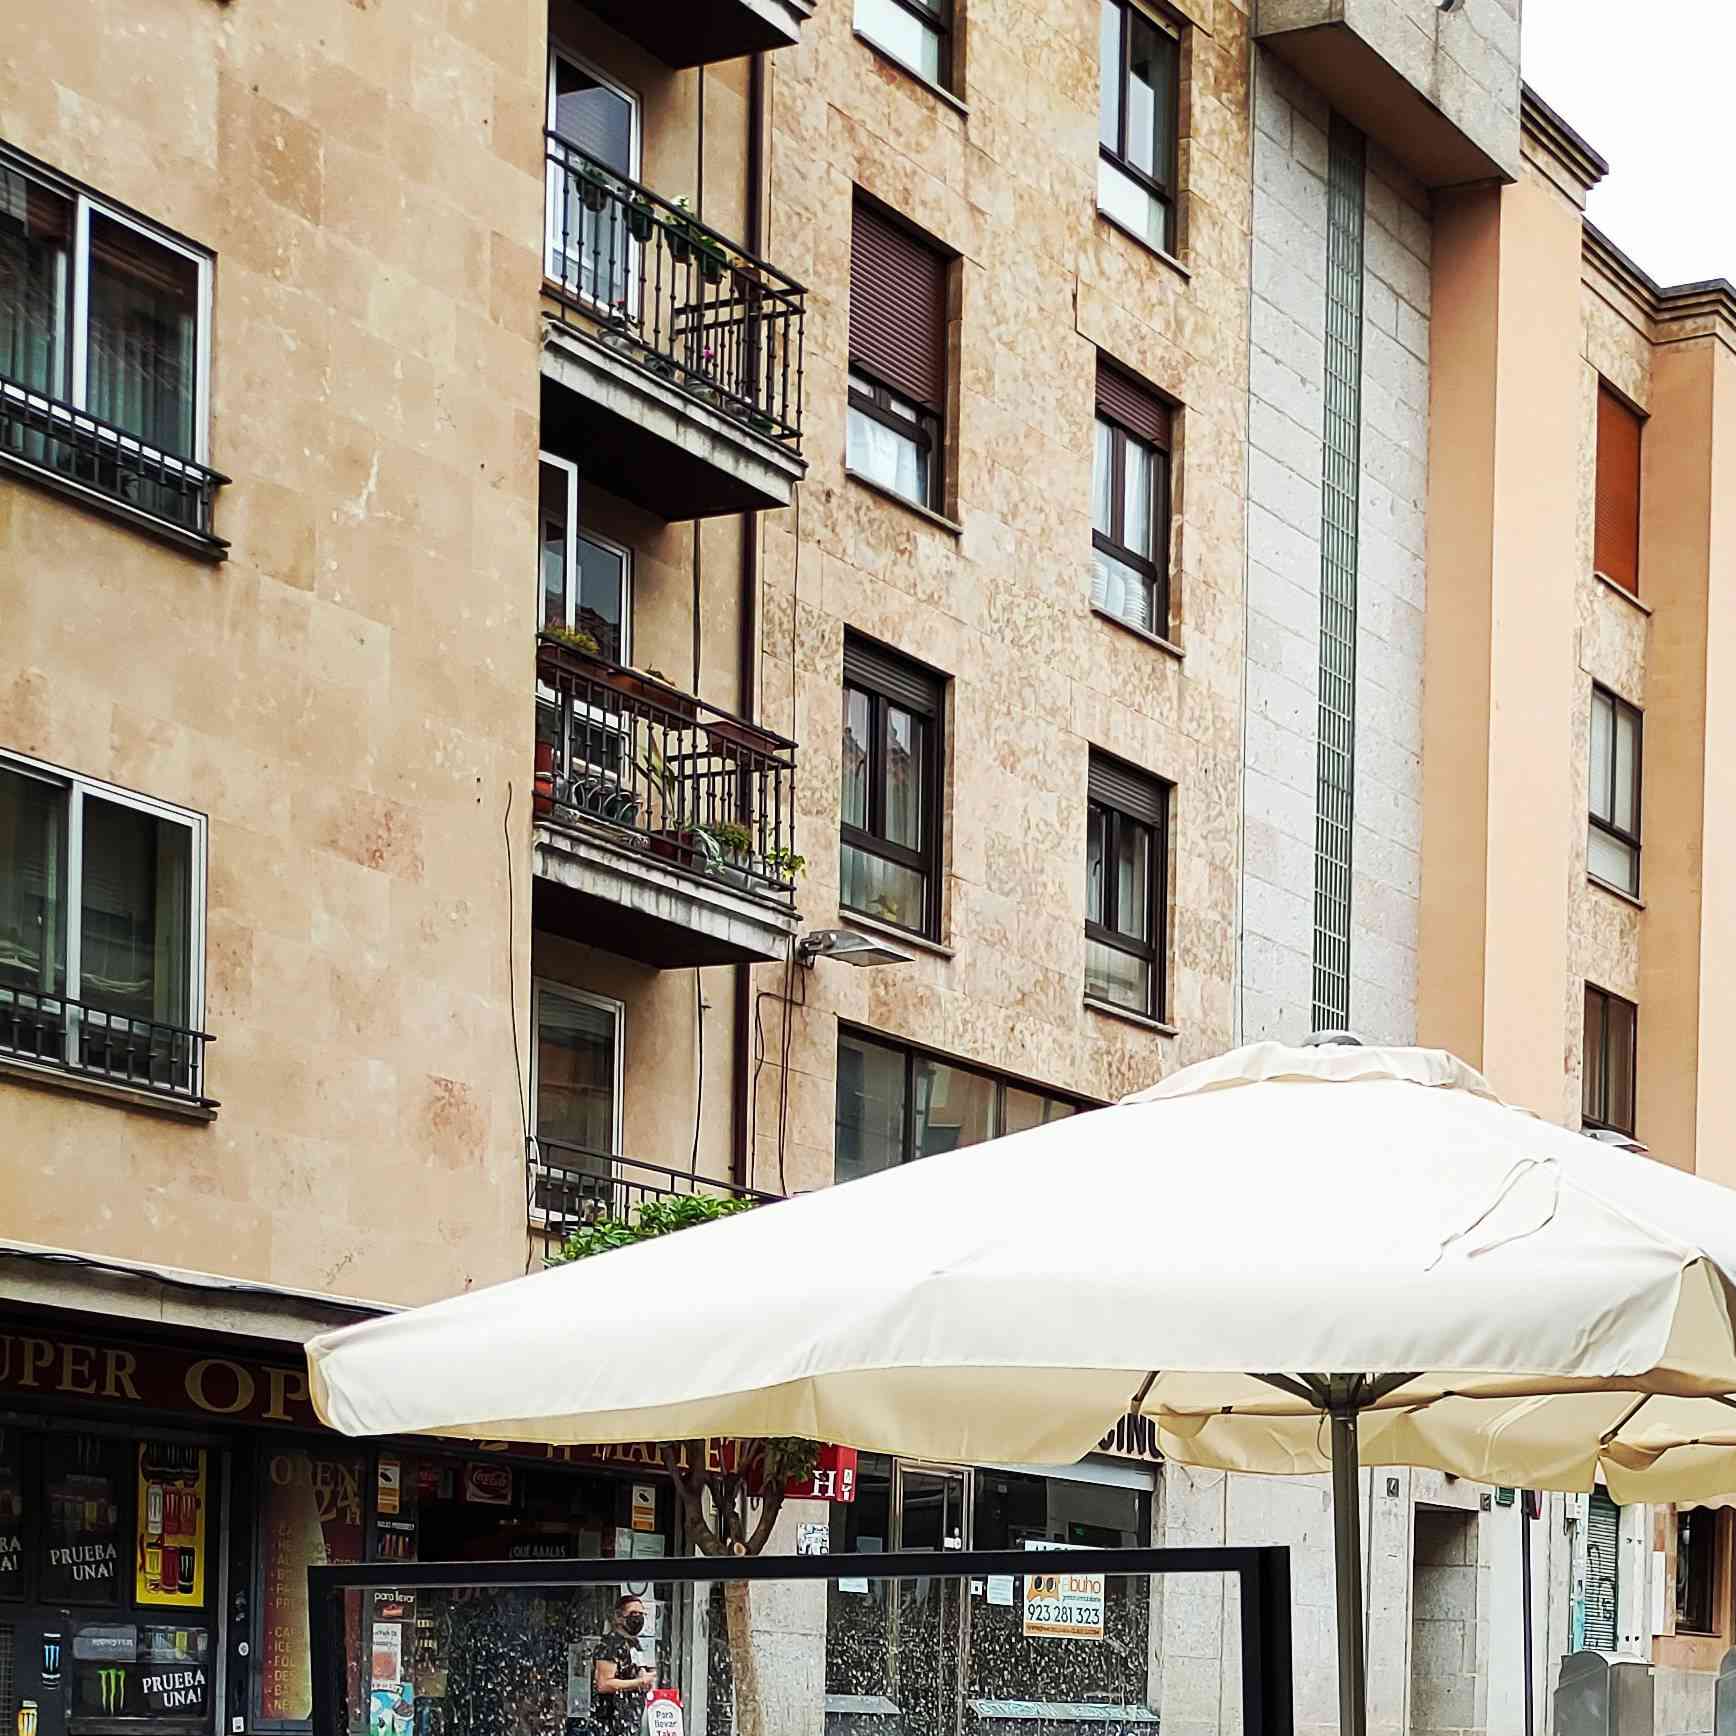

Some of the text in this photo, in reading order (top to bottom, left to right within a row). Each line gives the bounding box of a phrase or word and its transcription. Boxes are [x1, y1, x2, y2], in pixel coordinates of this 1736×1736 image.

[50, 1542, 117, 1566] PRUEBA
[72, 1562, 114, 1581] UNA!
[1027, 1603, 1100, 1625] 923 281 323
[142, 1669, 206, 1694] PRUEBA
[163, 1687, 202, 1708] UNA!
